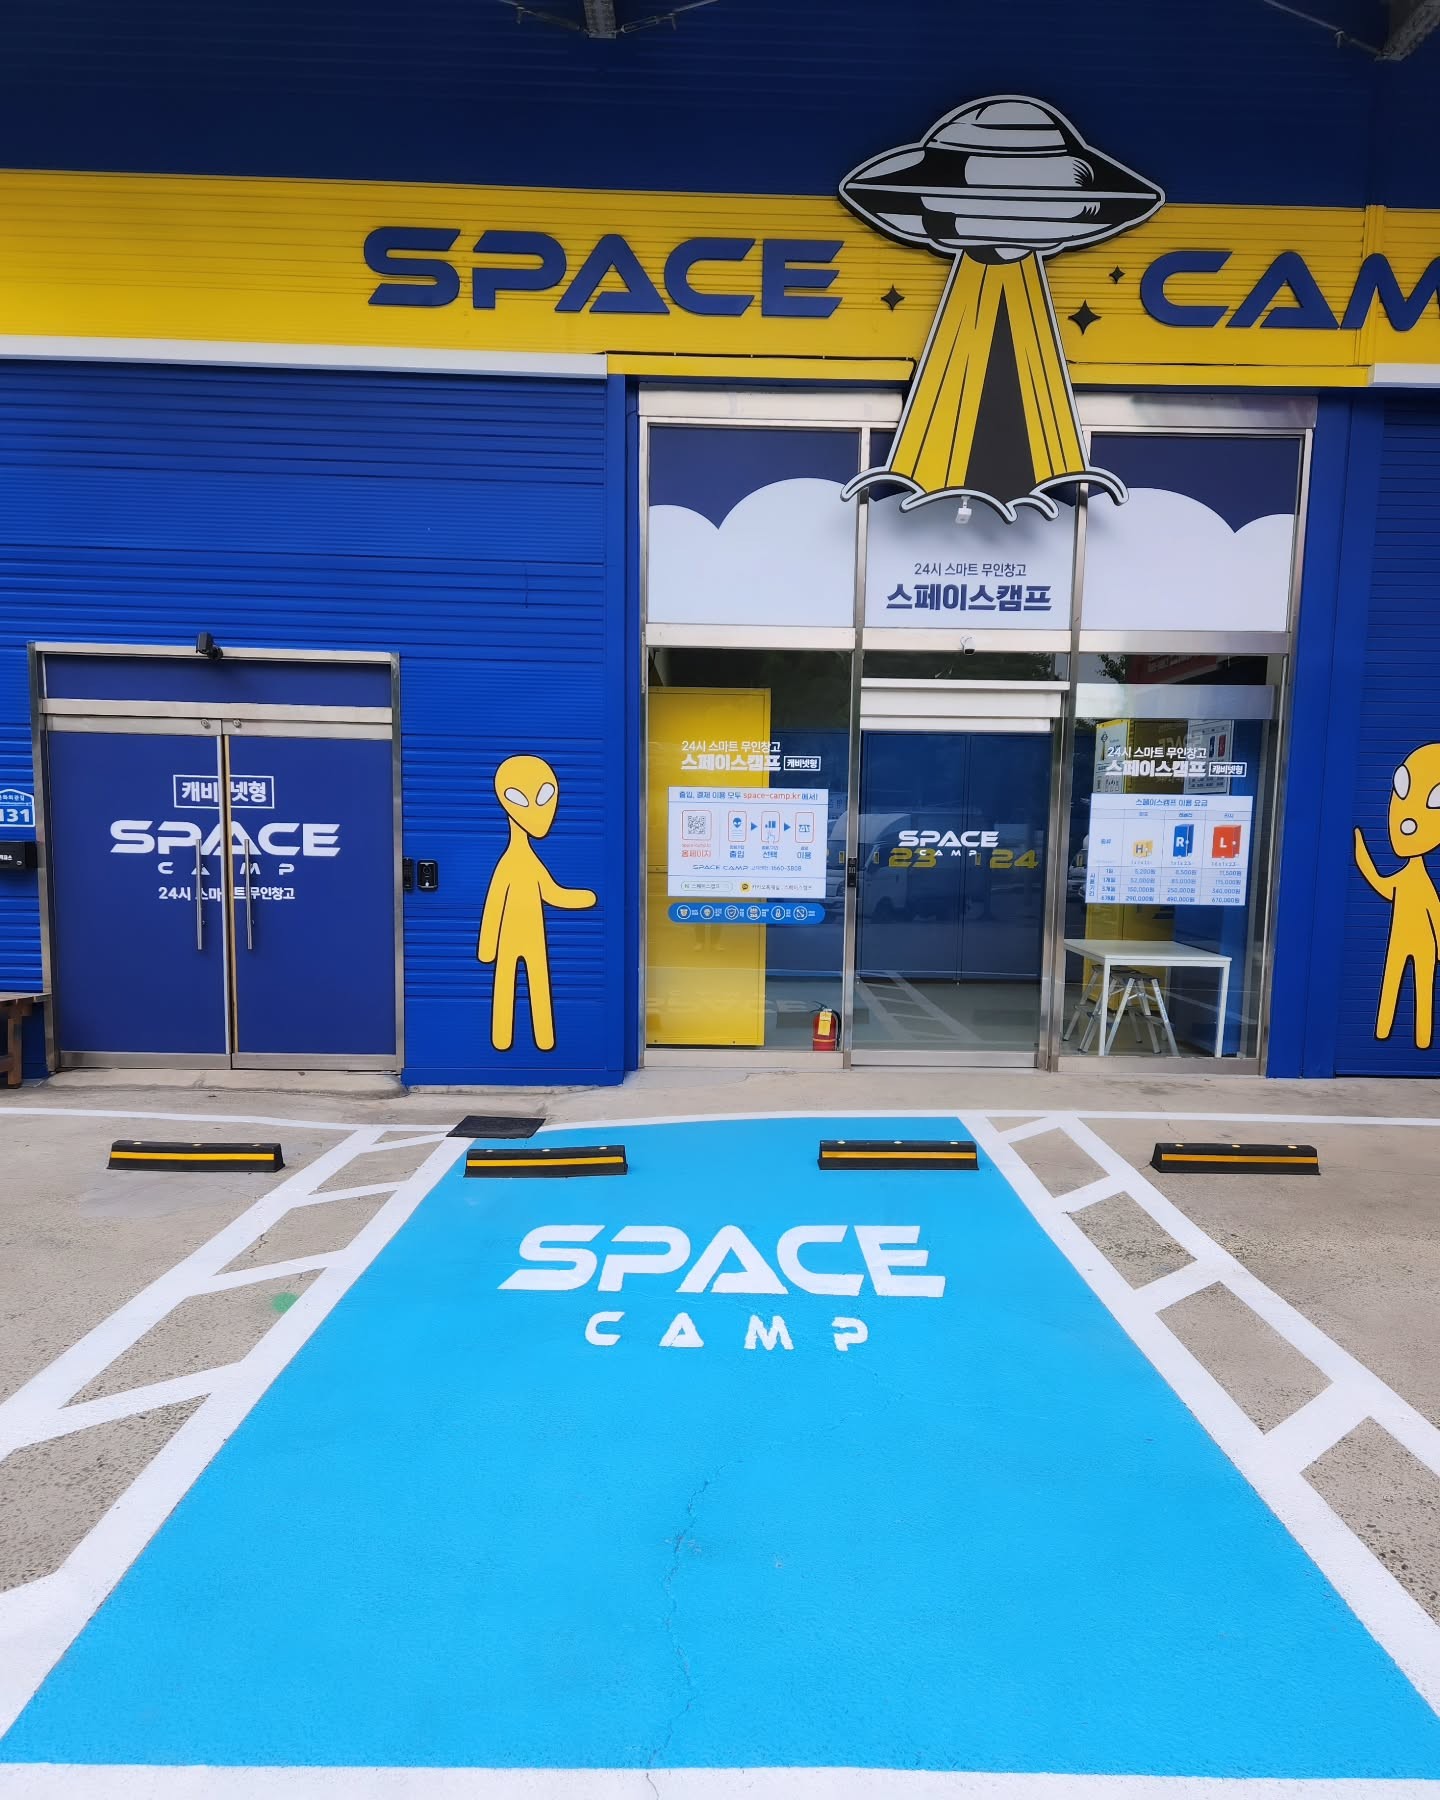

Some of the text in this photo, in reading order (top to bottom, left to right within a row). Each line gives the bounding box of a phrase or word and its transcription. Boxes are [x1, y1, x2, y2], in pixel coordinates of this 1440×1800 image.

[363, 226, 845, 318] SPACE
[914, 562, 1027, 578] 24시 스마트 무인창고
[886, 583, 1052, 612] 스페이스캠프
[681, 741, 781, 753] 24시 스마트 무인창고
[1107, 747, 1207, 759] 24시 스마트 무인창고
[680, 753, 818, 772] 스페이스캠프 캐비넷형
[1105, 759, 1206, 777] 스페이스캠프
[181, 780, 267, 803] 캐비넷형
[109, 819, 341, 857] SPACE
[898, 830, 1000, 848] SPACE
[1176, 837, 1184, 847] R
[1220, 837, 1227, 848] L
[919, 849, 978, 857] CAMP
[989, 848, 1039, 869] 24
[157, 861, 295, 876] CAMP
[158, 886, 191, 901] 24시
[250, 886, 296, 901] 무인창고
[496, 1224, 946, 1298] SPACE
[584, 1311, 868, 1351] CAMP
